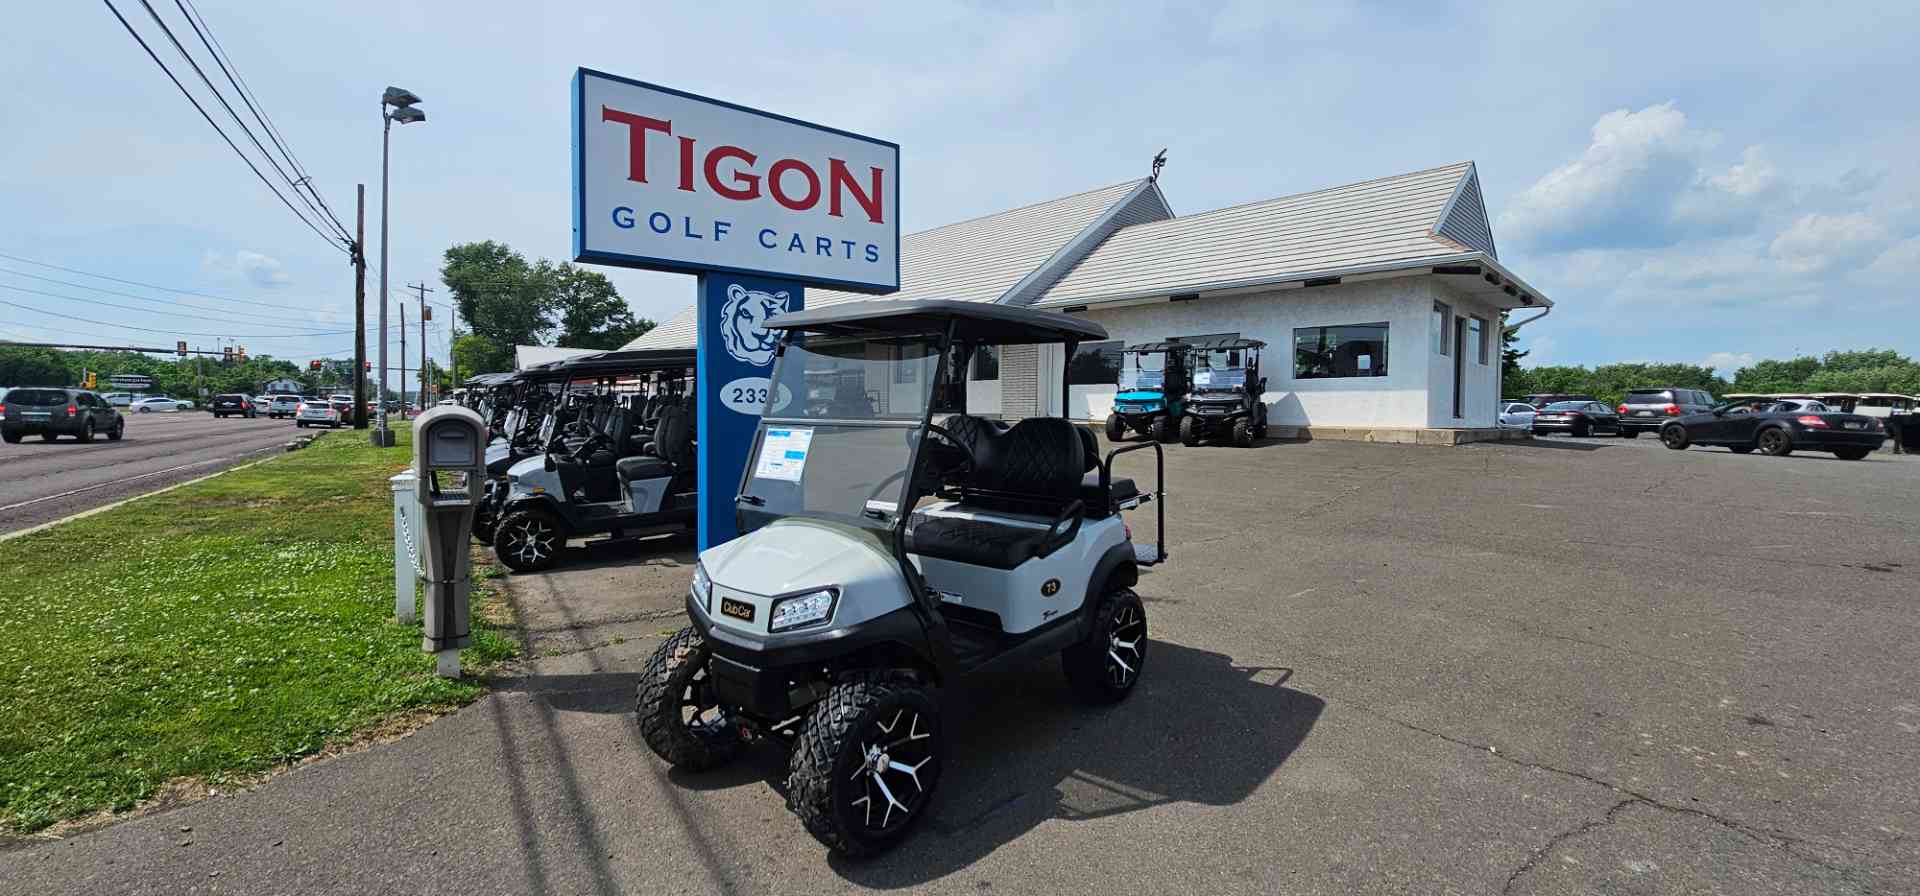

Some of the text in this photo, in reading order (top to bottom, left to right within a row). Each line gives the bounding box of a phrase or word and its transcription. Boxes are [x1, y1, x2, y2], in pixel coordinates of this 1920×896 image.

[602, 104, 884, 224] TIGON
[612, 206, 879, 263] GOLF CARTS
